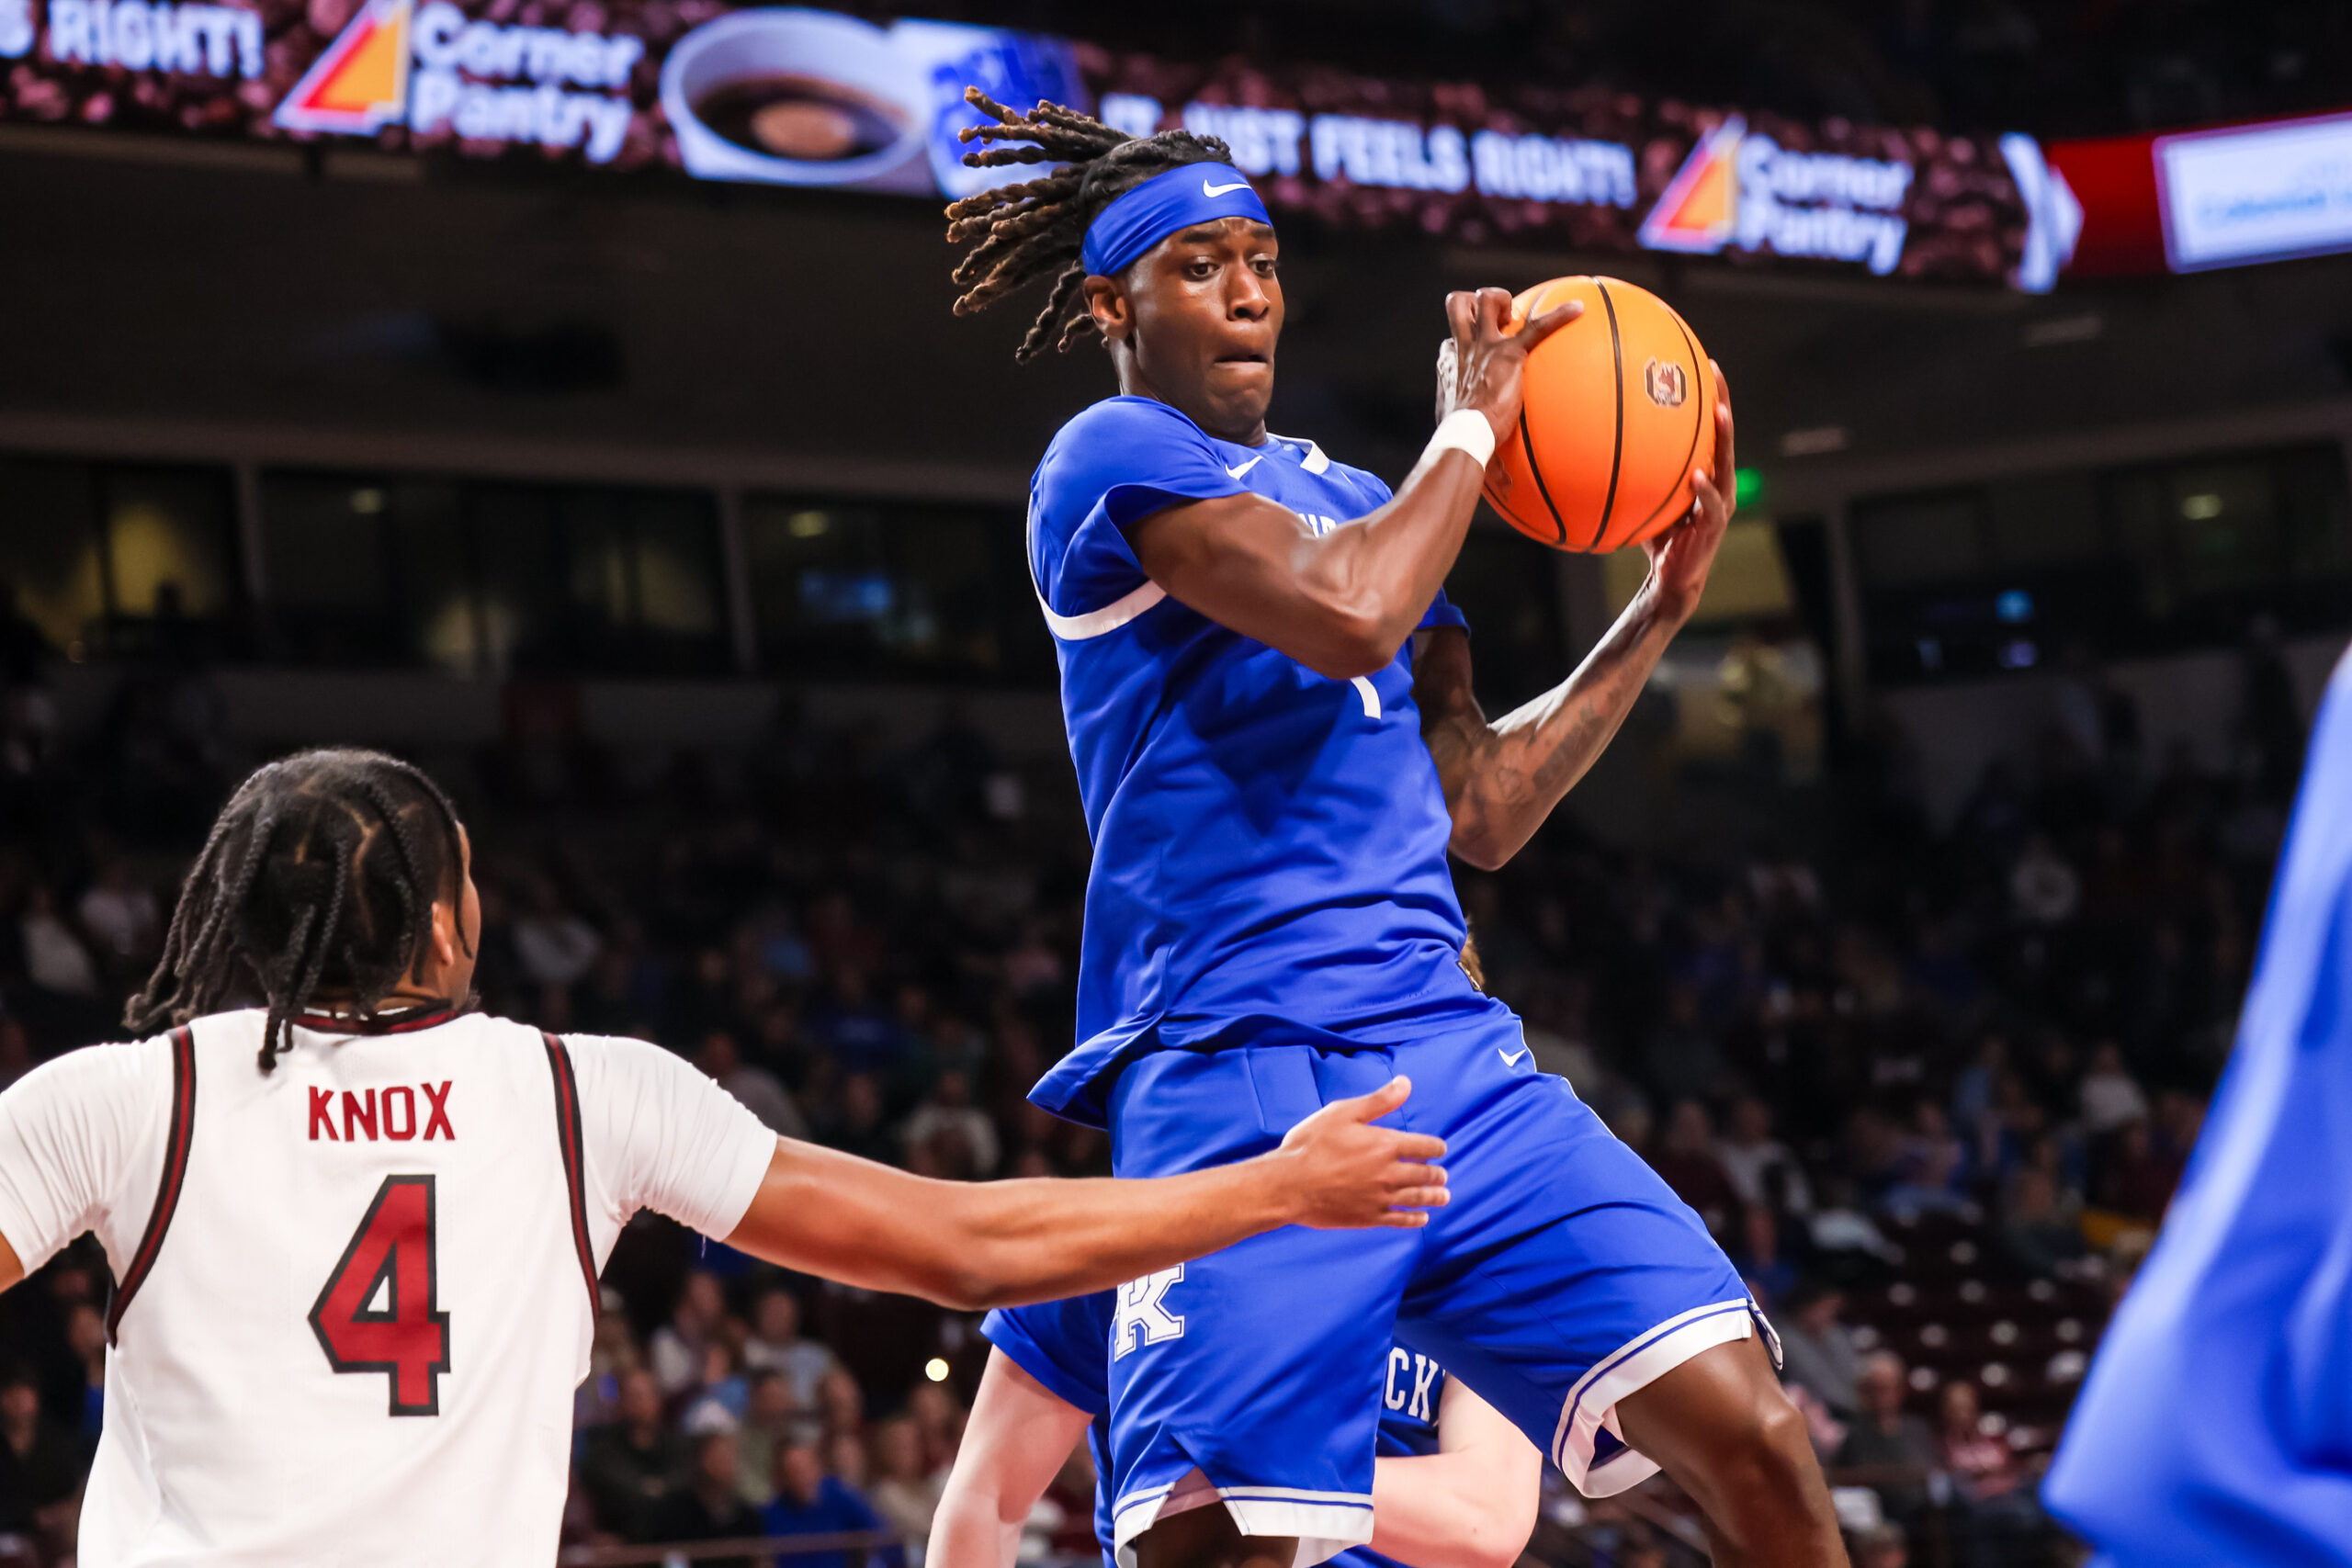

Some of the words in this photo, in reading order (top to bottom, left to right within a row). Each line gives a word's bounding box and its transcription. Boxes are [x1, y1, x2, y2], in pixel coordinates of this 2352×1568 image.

[49, 0, 265, 79] RIGHT!
[412, 1, 644, 87] Corner
[411, 66, 632, 163] Pantry
[1309, 112, 1469, 194] FEELS
[1736, 133, 1914, 210] Corner
[1736, 195, 1907, 275] Pantry
[308, 1080, 456, 1142] KNOX
[308, 1174, 450, 1416] 4
